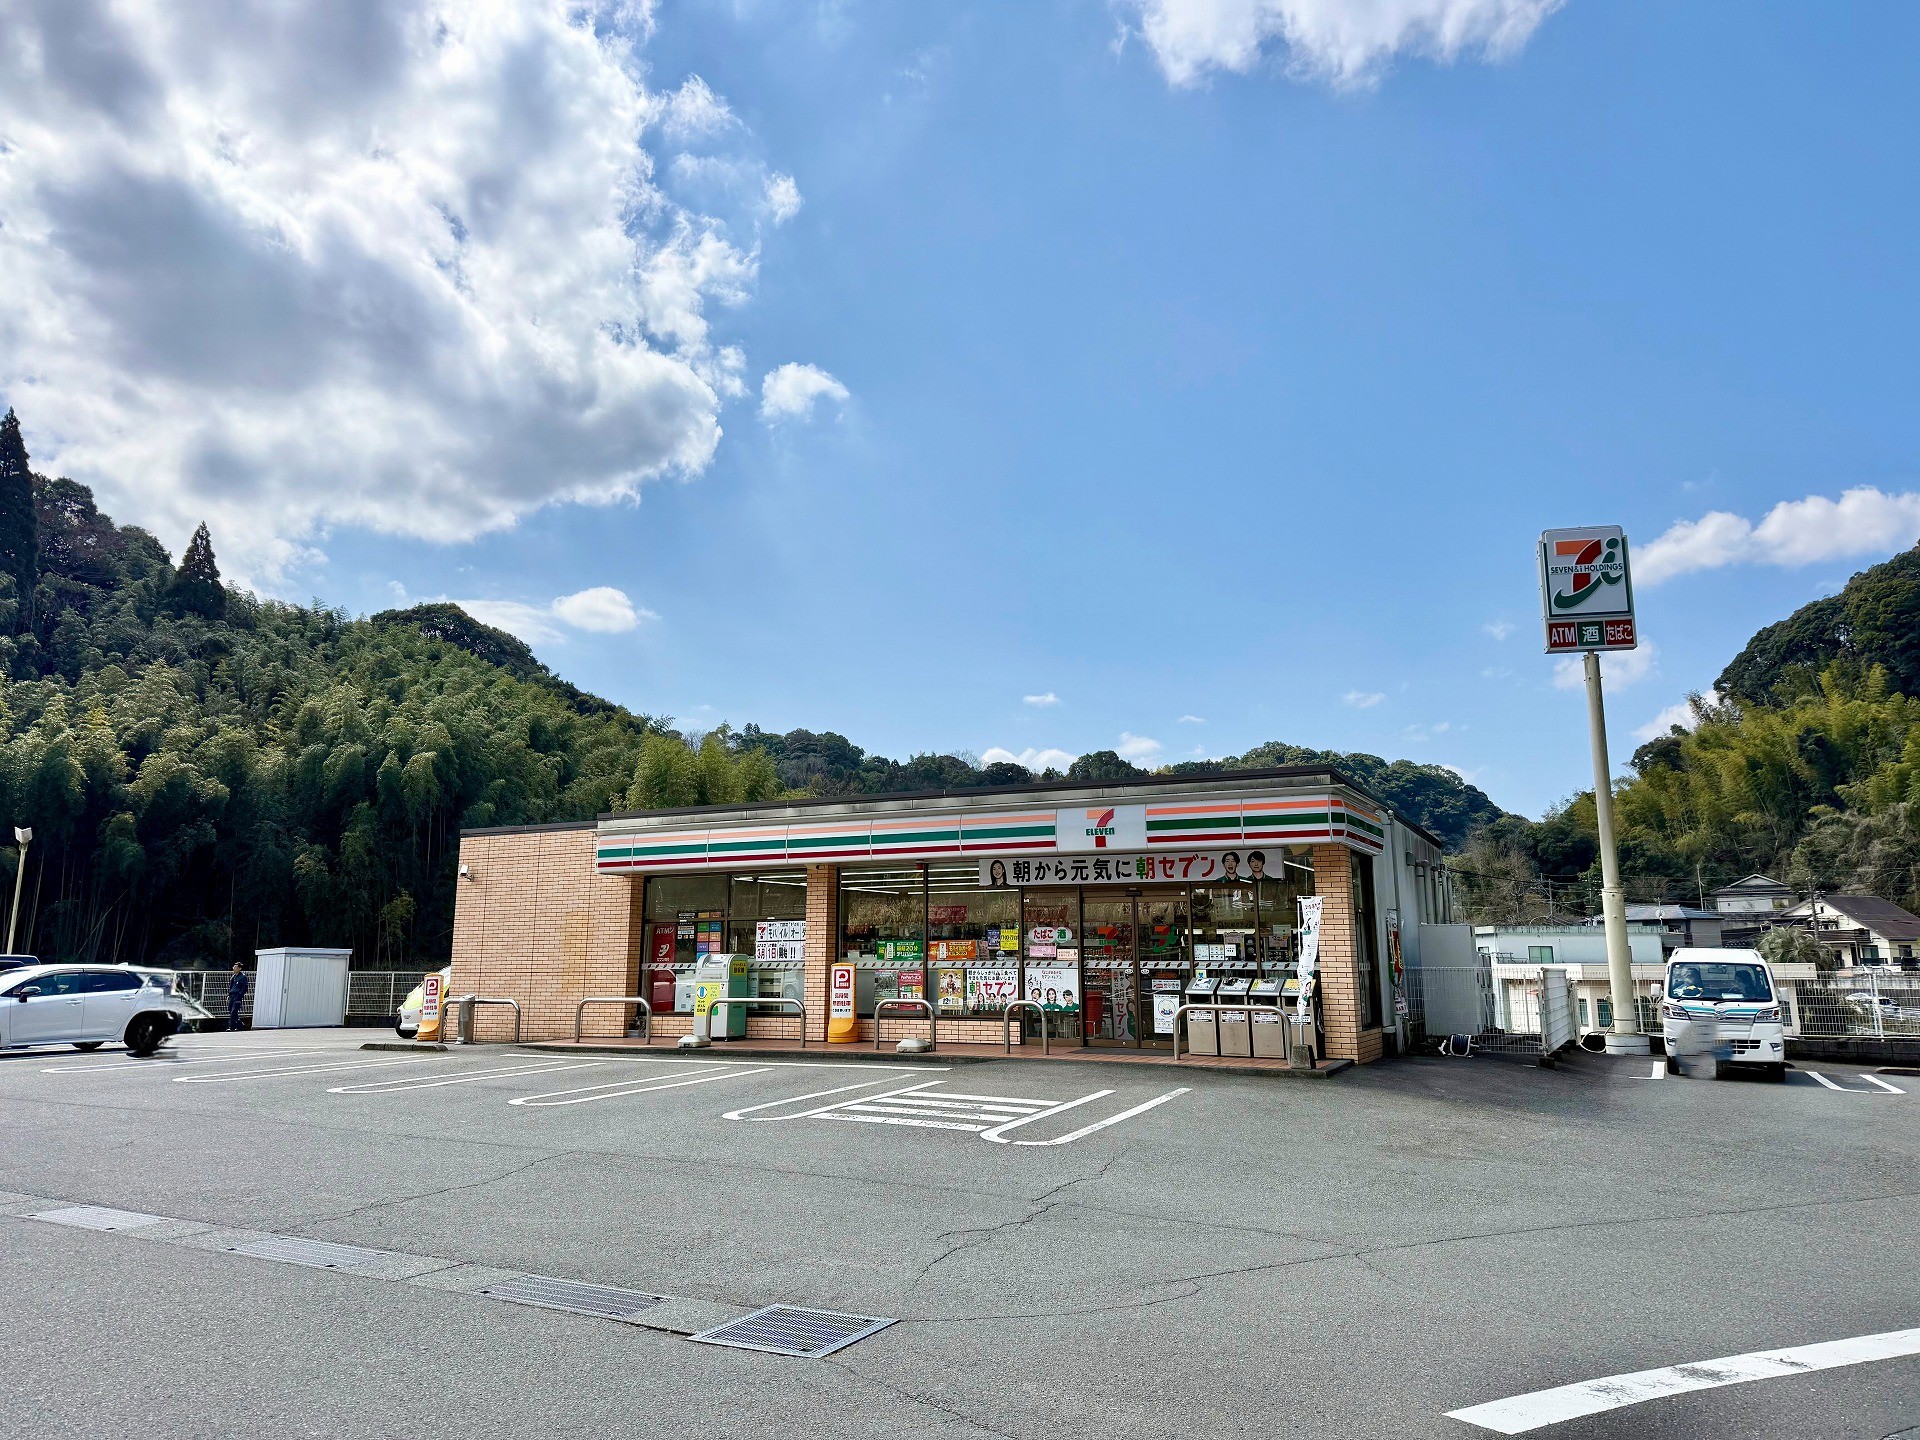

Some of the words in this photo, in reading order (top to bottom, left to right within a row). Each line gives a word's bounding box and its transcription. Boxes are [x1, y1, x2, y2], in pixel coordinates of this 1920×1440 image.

[1551, 627, 1575, 643] ATM
[1582, 626, 1599, 642] 酒
[1606, 624, 1633, 640] たばこ
[1012, 853, 1215, 883] 朝から元気に朝セブン
[1033, 929, 1054, 940] たばこ
[1057, 929, 1067, 939] 酒
[968, 981, 1017, 997] 朝セブン
